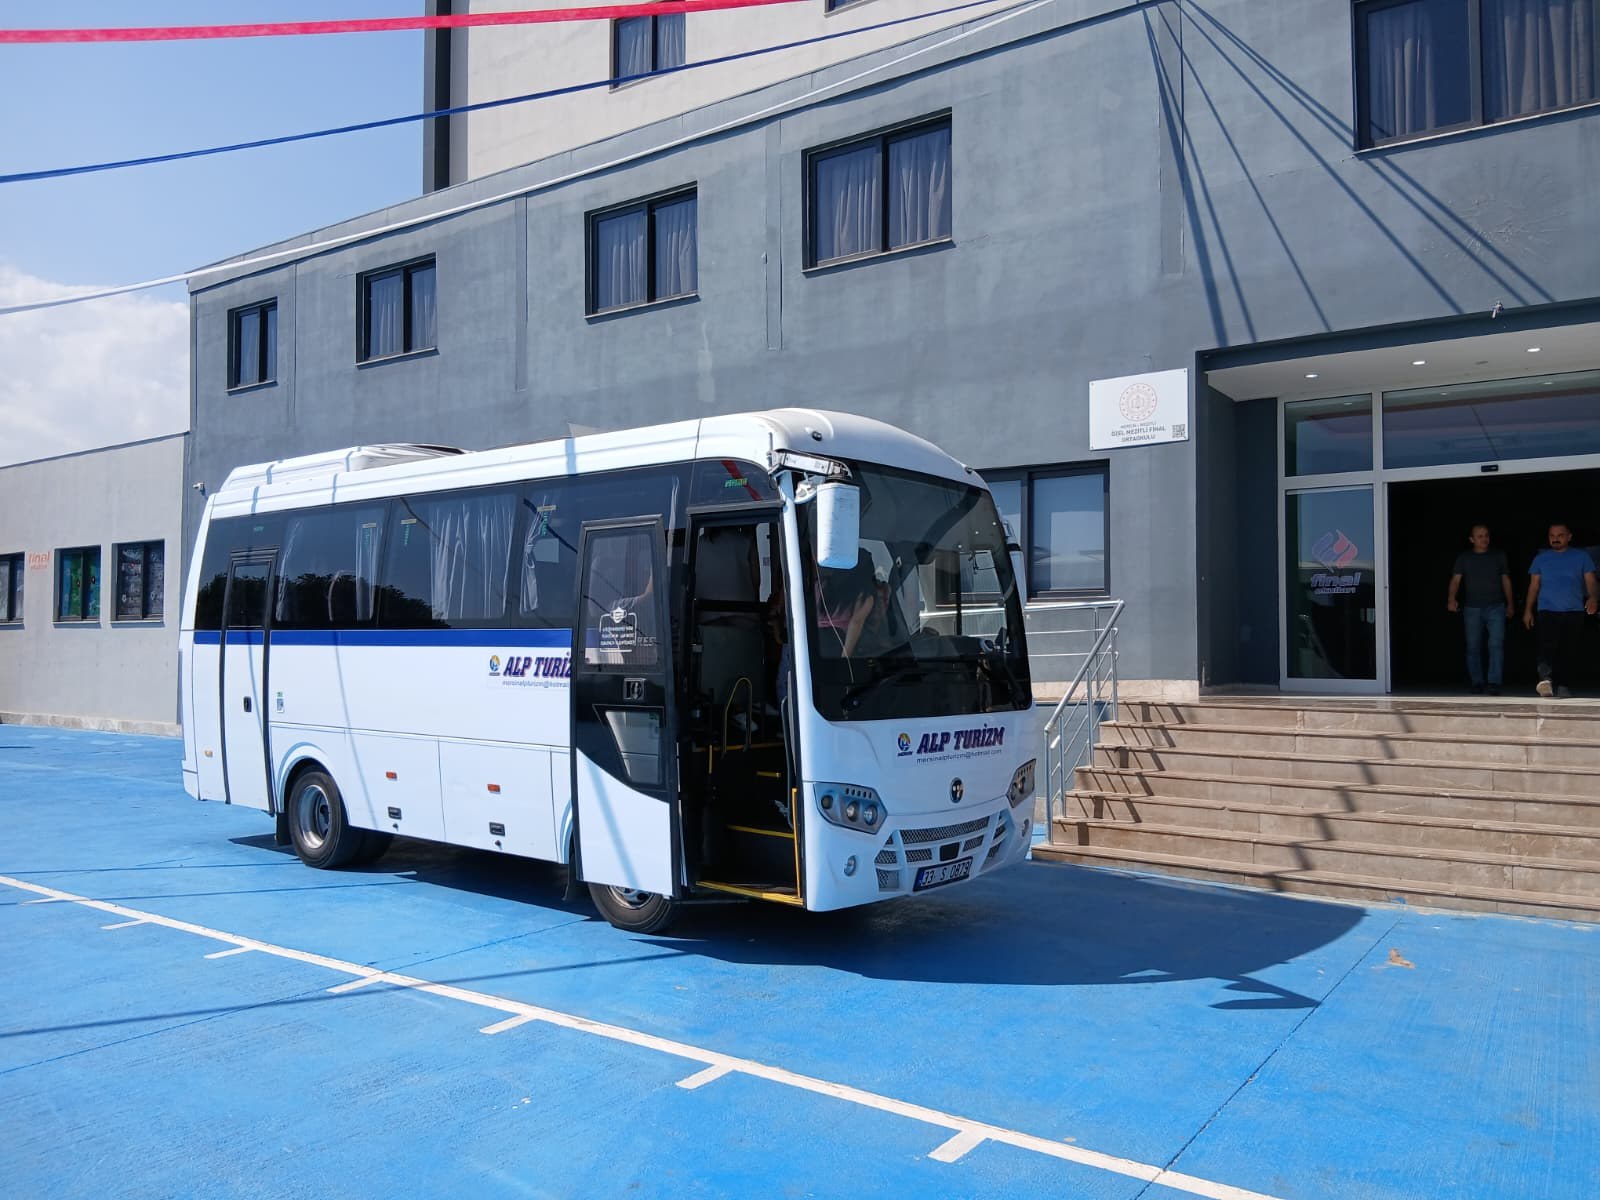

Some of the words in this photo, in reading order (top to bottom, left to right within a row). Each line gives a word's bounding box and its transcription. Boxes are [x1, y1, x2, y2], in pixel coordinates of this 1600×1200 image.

[503, 656, 532, 677] ALP
[917, 732, 951, 754] ALP
[953, 723, 1005, 750] TURİZM
[922, 870, 935, 885] 33
[940, 867, 947, 880] S
